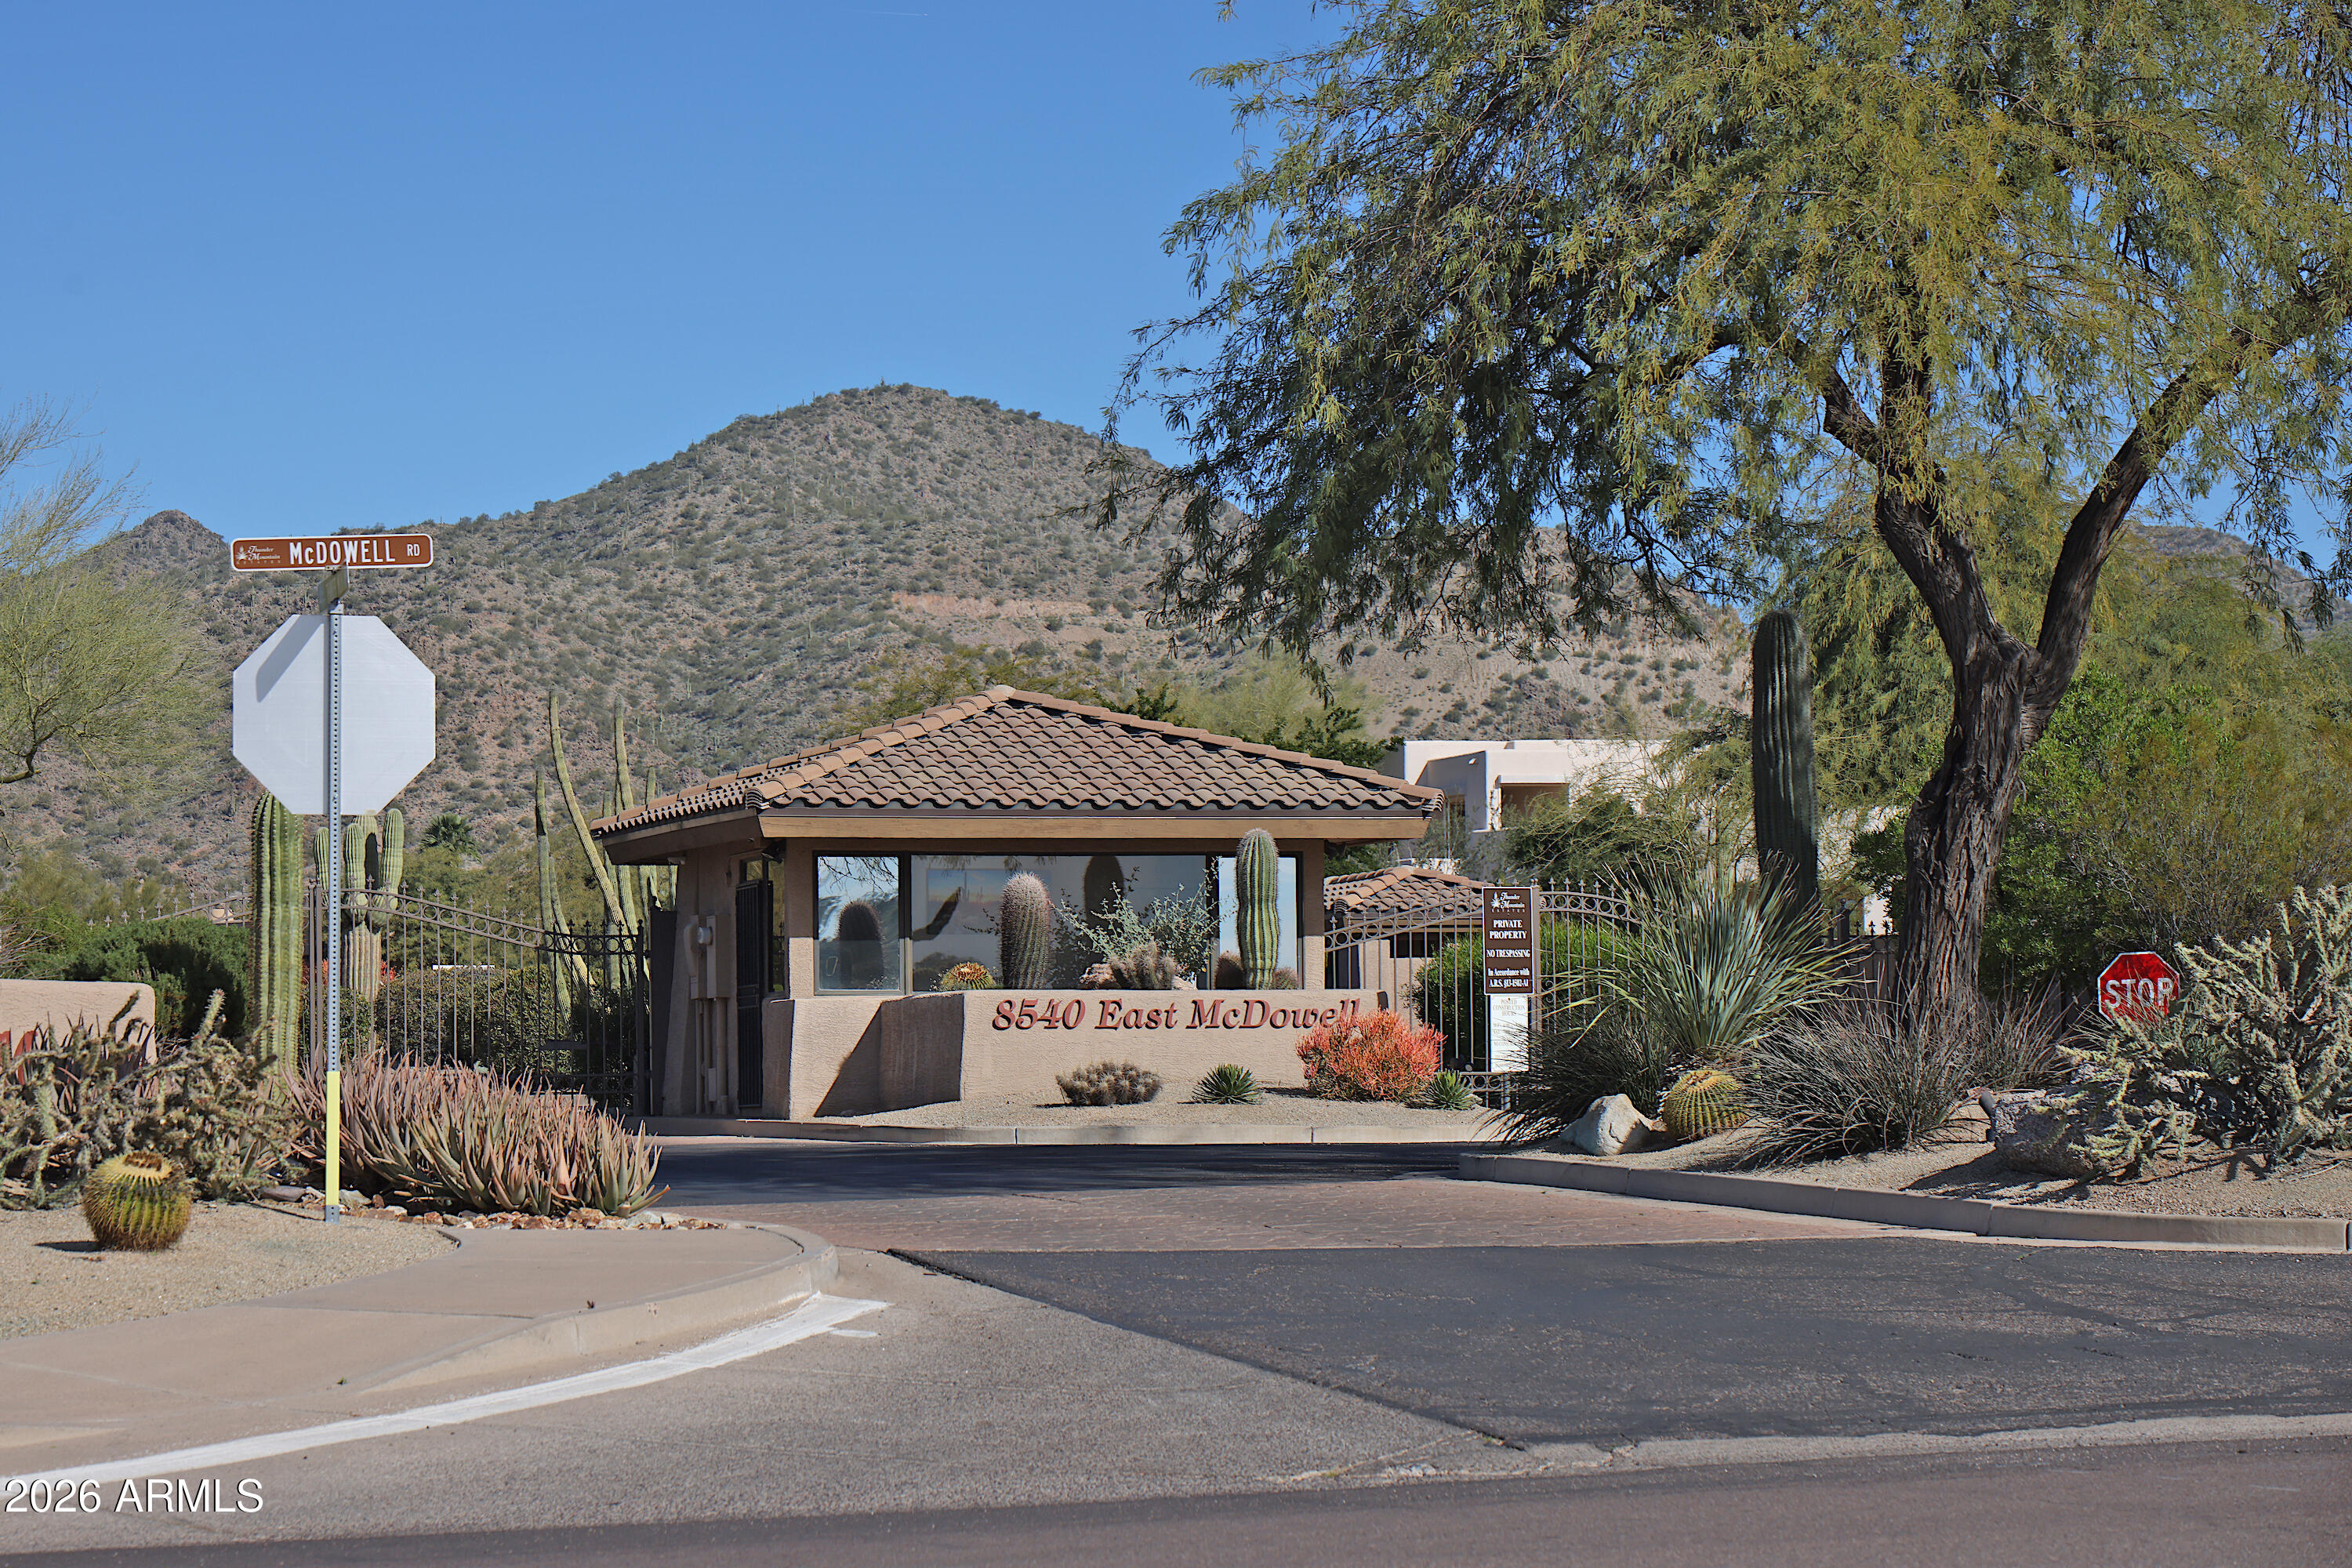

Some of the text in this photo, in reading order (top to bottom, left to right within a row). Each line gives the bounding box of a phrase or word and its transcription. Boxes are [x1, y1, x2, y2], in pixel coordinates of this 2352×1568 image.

[248, 545, 274, 554] Thunder
[289, 539, 420, 565] McDOWELL RD
[1500, 900, 1526, 909] Mountain
[1493, 919, 1523, 928] PRIVATE
[1489, 930, 1527, 939] PROPERTY
[1486, 949, 1530, 958] NO TRESPASSING
[1487, 967, 1530, 976] In Accordance with
[2104, 977, 2174, 1009] STOP
[992, 997, 1361, 1031] 8540 East McDowell
